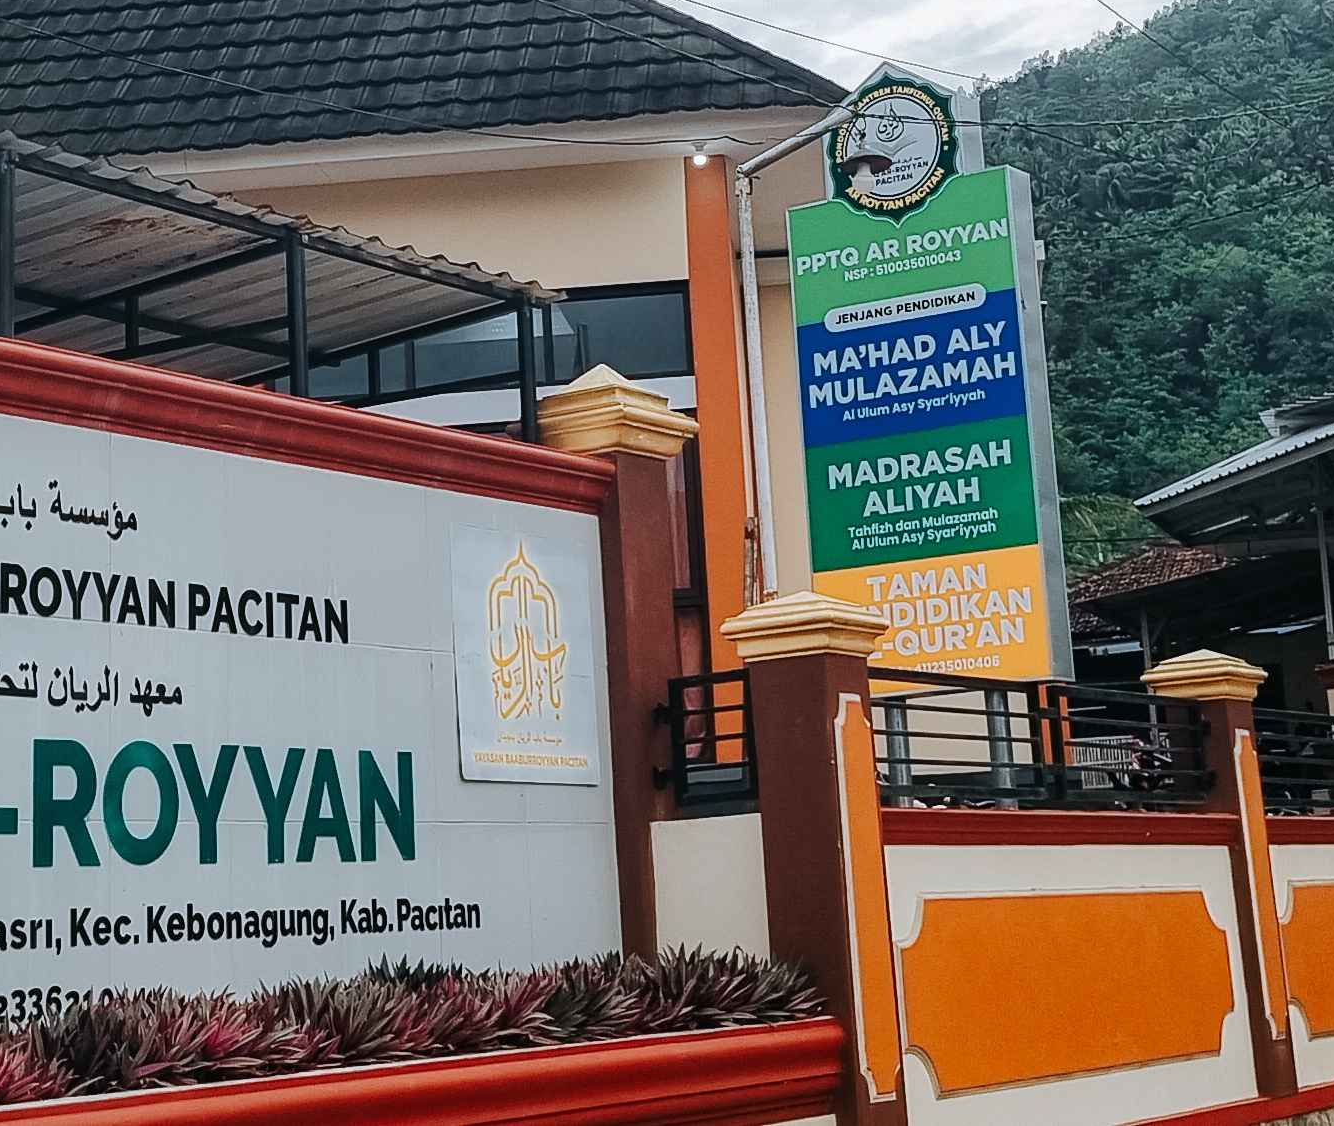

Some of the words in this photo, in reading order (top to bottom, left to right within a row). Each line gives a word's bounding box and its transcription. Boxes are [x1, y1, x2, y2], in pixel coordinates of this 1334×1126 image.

[858, 193, 905, 211] ROYYAN
[904, 166, 946, 205] PACITAN
[796, 247, 860, 275] PPTQ
[866, 238, 900, 262] AR
[906, 217, 1009, 255] ROYYAN
[844, 267, 867, 282] NSP
[835, 305, 893, 325] JENJANG
[896, 291, 976, 315] PENDIDIKAN
[813, 333, 937, 377] MA'HAD
[946, 320, 1007, 355] ALY
[808, 351, 1017, 409] MULAZAMAH
[842, 408, 856, 422] Al
[857, 404, 890, 419] Ulum
[892, 400, 916, 416] Asy
[828, 439, 1012, 490] MADRASAH
[49, 480, 138, 540] مؤسسة
[863, 476, 980, 518] ALIYAH
[847, 521, 894, 539] Tahfizh
[895, 518, 921, 532] dan
[922, 507, 999, 529] Mulazamah
[851, 538, 865, 551] Al
[866, 534, 900, 549] Ulum
[901, 531, 925, 547] Asy
[866, 563, 988, 602] TAMAN
[188, 582, 349, 646] PACITAN
[866, 586, 1033, 628] NDIDIKAN
[868, 616, 1026, 659] -QUR'AN
[47, 664, 119, 714] الريان
[129, 673, 184, 717] معهد
[68, 906, 141, 948] Kec.
[145, 901, 335, 948] Kebonagung,
[339, 898, 394, 934] Kab.
